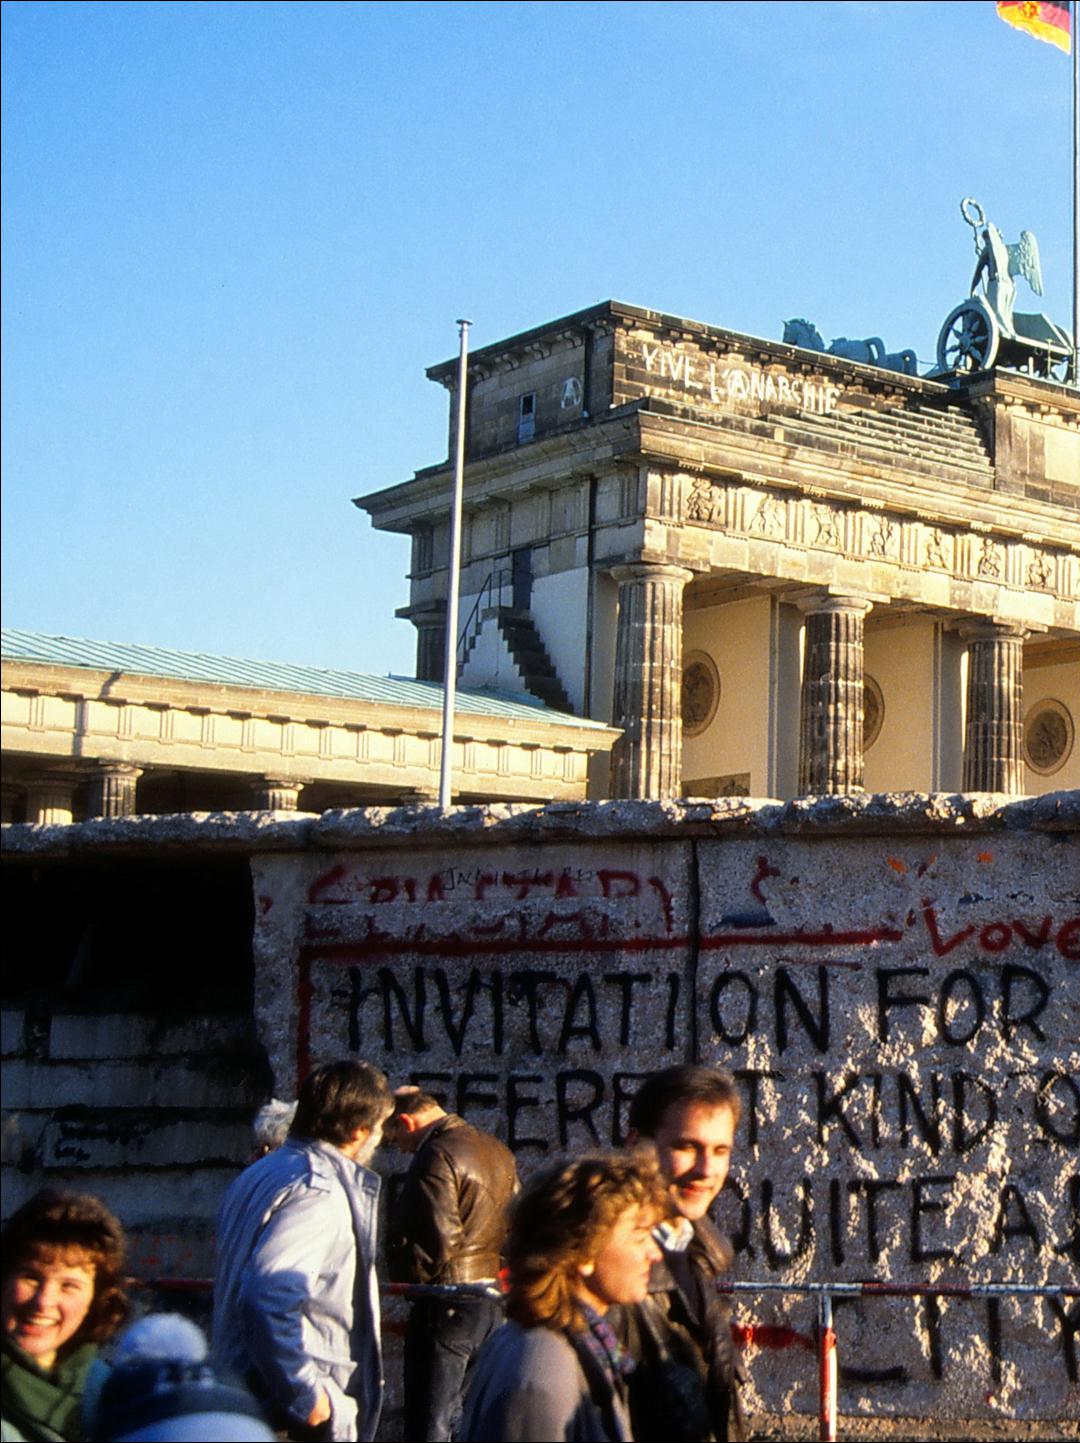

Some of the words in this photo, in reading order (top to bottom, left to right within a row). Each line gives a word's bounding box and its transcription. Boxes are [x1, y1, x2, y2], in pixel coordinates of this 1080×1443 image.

[643, 343, 702, 390] VIVE
[334, 965, 829, 1056] INVITATION
[876, 966, 1049, 1048] FOR
[811, 1069, 999, 1157] KIND
[988, 1184, 1042, 1256] A
